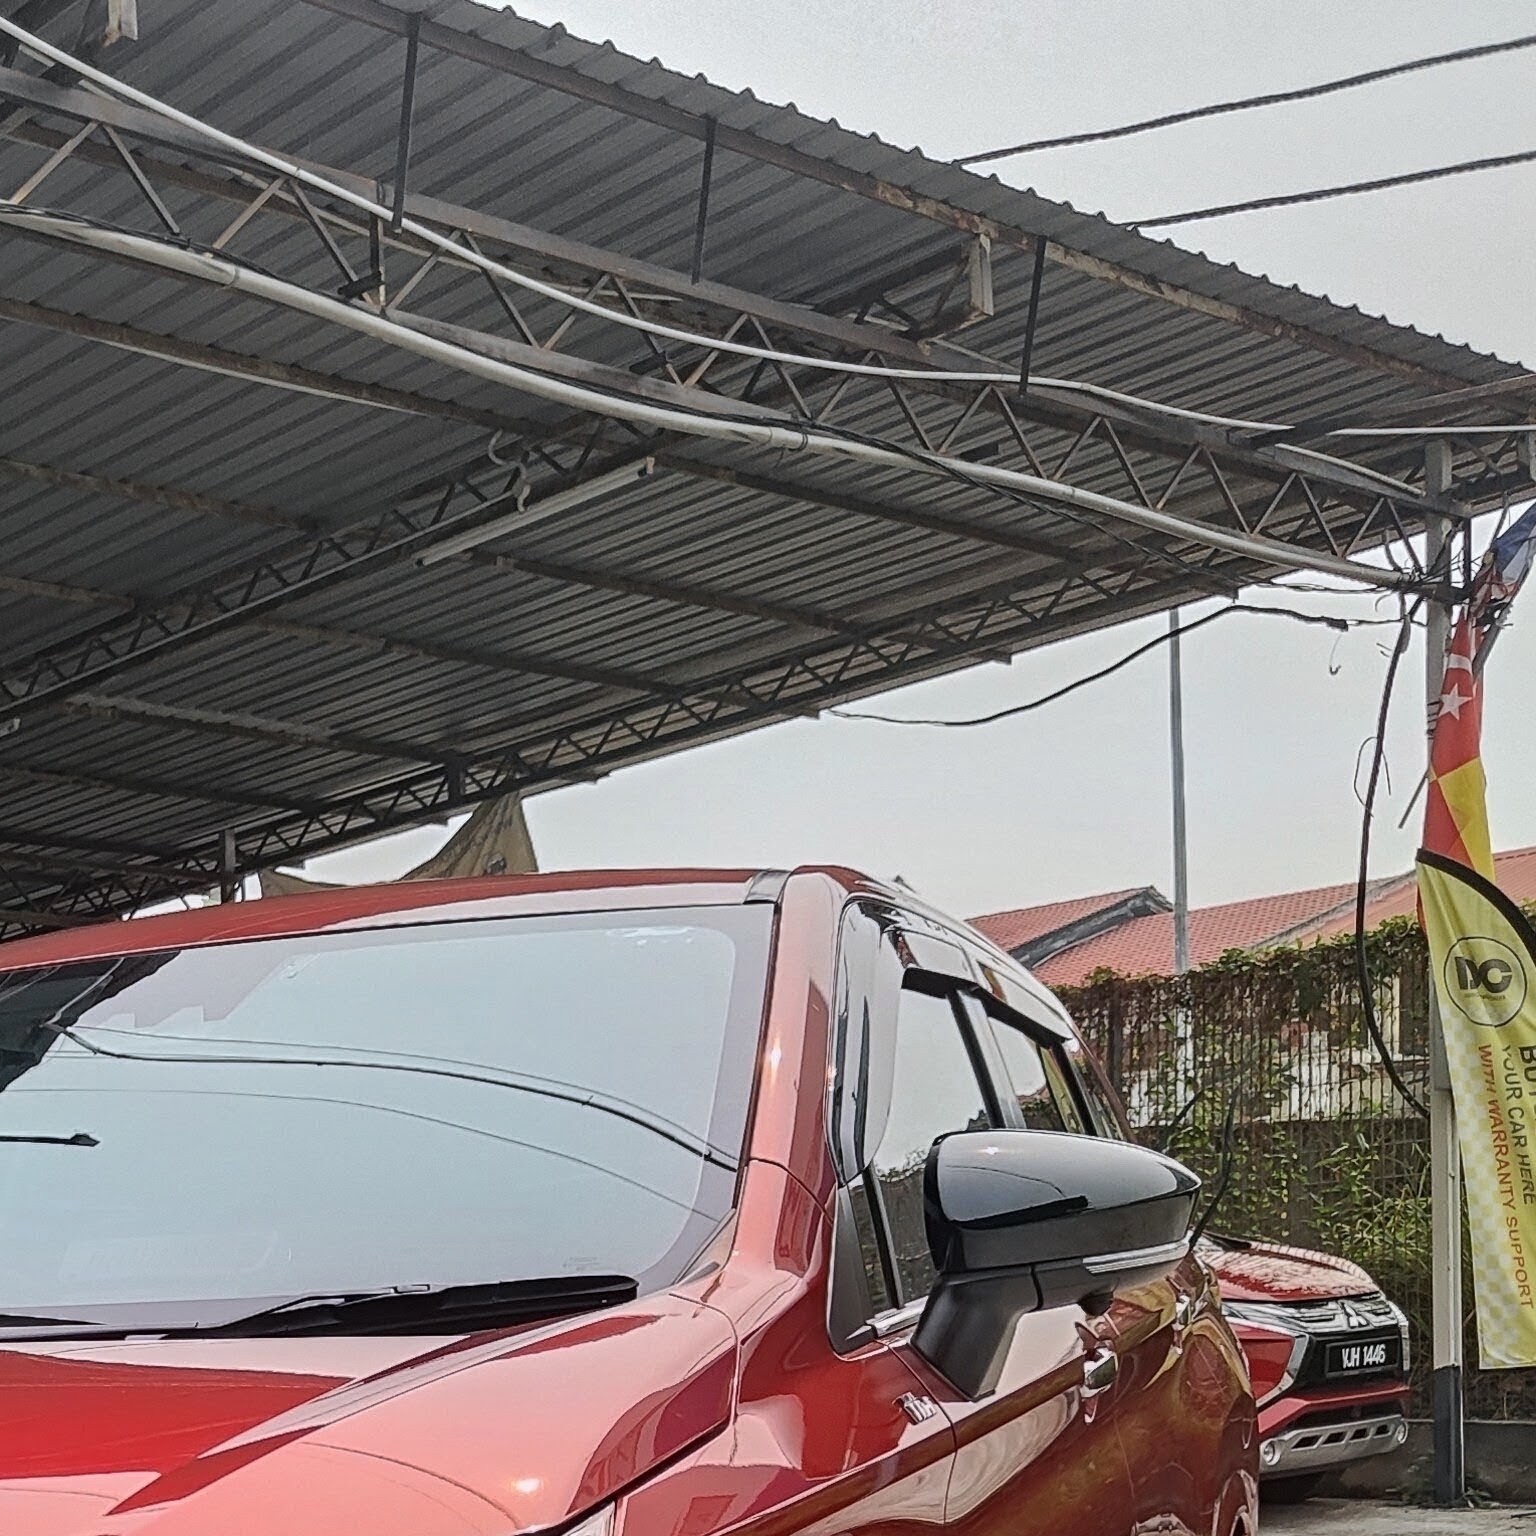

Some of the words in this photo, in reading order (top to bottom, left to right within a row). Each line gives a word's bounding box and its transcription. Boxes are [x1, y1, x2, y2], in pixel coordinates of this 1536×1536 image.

[1454, 956, 1513, 994] DC
[1478, 1044, 1497, 1093] WITH
[1502, 1044, 1523, 1101] YOUR
[1507, 1106, 1528, 1148] CAR
[1487, 1099, 1517, 1211] WARRANTY
[1516, 1152, 1536, 1205] HERE
[1506, 1215, 1535, 1309] SUPPORT
[1363, 1343, 1386, 1366] 1446
